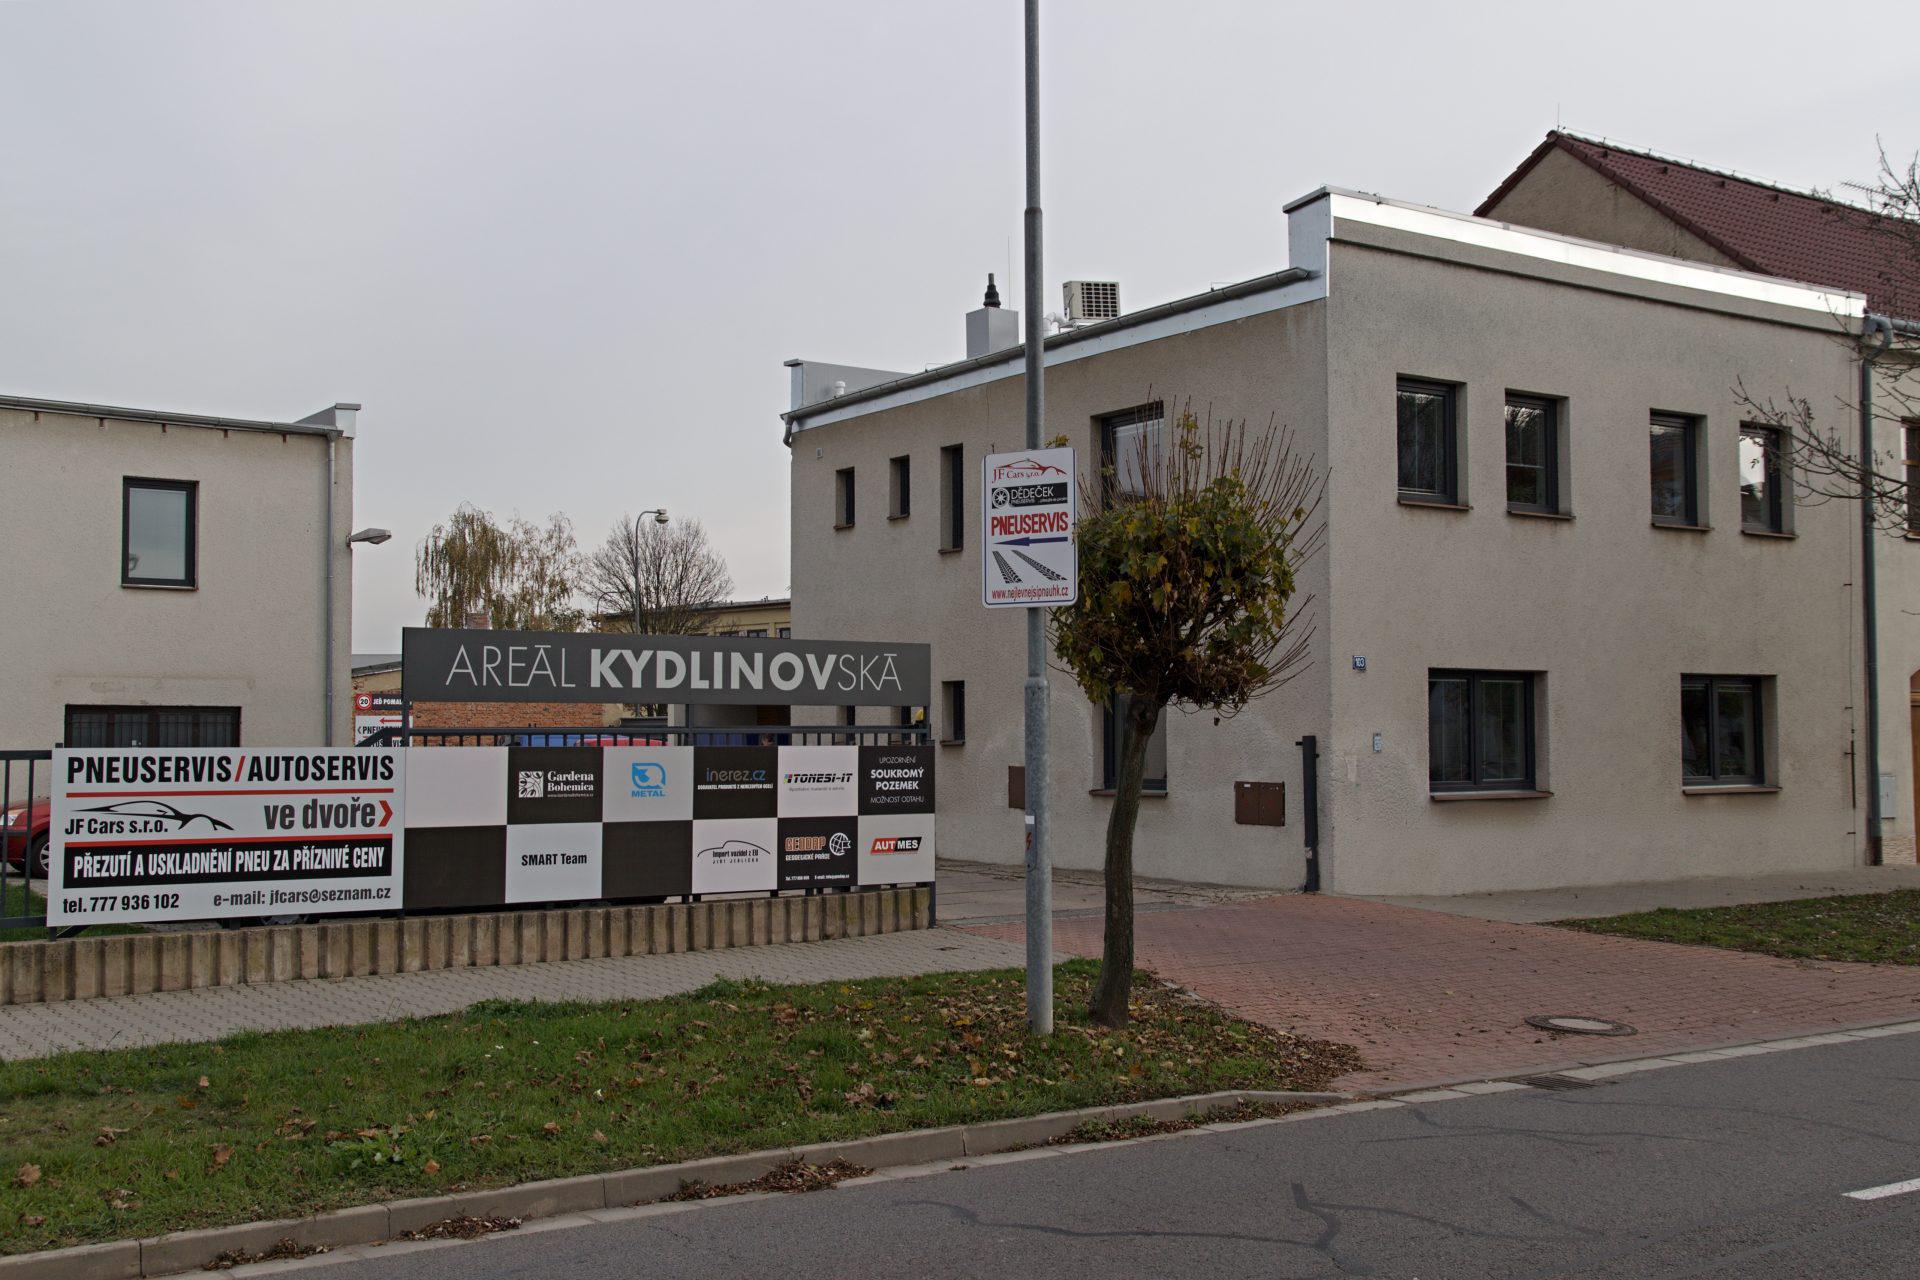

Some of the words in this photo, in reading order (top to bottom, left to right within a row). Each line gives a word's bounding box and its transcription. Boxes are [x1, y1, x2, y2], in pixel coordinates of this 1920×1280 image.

[992, 468, 1005, 483] JF
[1007, 470, 1024, 479] Cars
[1011, 486, 1054, 500] DĚDEČEK
[991, 511, 1069, 536] PNEUSERVIS
[879, 755, 917, 764] UPOZORNĚNÍ
[547, 770, 594, 782] Gardena
[706, 767, 766, 782] inerez.cz
[870, 766, 924, 779] SOUKROMÝ
[547, 782, 594, 792] Bohemica
[876, 780, 919, 791] POZEMEK
[631, 790, 666, 798] METAL
[870, 795, 900, 804] MOŽNOST
[901, 795, 924, 803] ODTAHU
[264, 803, 296, 830] ve
[301, 796, 376, 829] dvoře
[65, 819, 85, 835] JF
[87, 817, 124, 834] Cars
[129, 818, 169, 833] s.r.o.
[785, 836, 827, 852] GEODAP
[74, 851, 132, 879] PŘEZUTÍ
[134, 854, 145, 876] A
[148, 847, 233, 875] USKLADNĚNÍ
[235, 849, 271, 873] PNEU
[273, 850, 290, 872] ZA
[292, 843, 350, 871] PŘÍZNIVÉ
[352, 846, 385, 869] CENY
[521, 853, 558, 867] SMART
[560, 853, 587, 865] Team
[712, 850, 730, 859] Import
[730, 849, 748, 857] vozidel
[62, 897, 87, 913] tel.
[89, 896, 117, 911] 777
[121, 895, 150, 910] 936
[153, 893, 179, 909] 102
[213, 890, 267, 907] e-mail:
[269, 885, 391, 906] jfcars@seznam.cz
